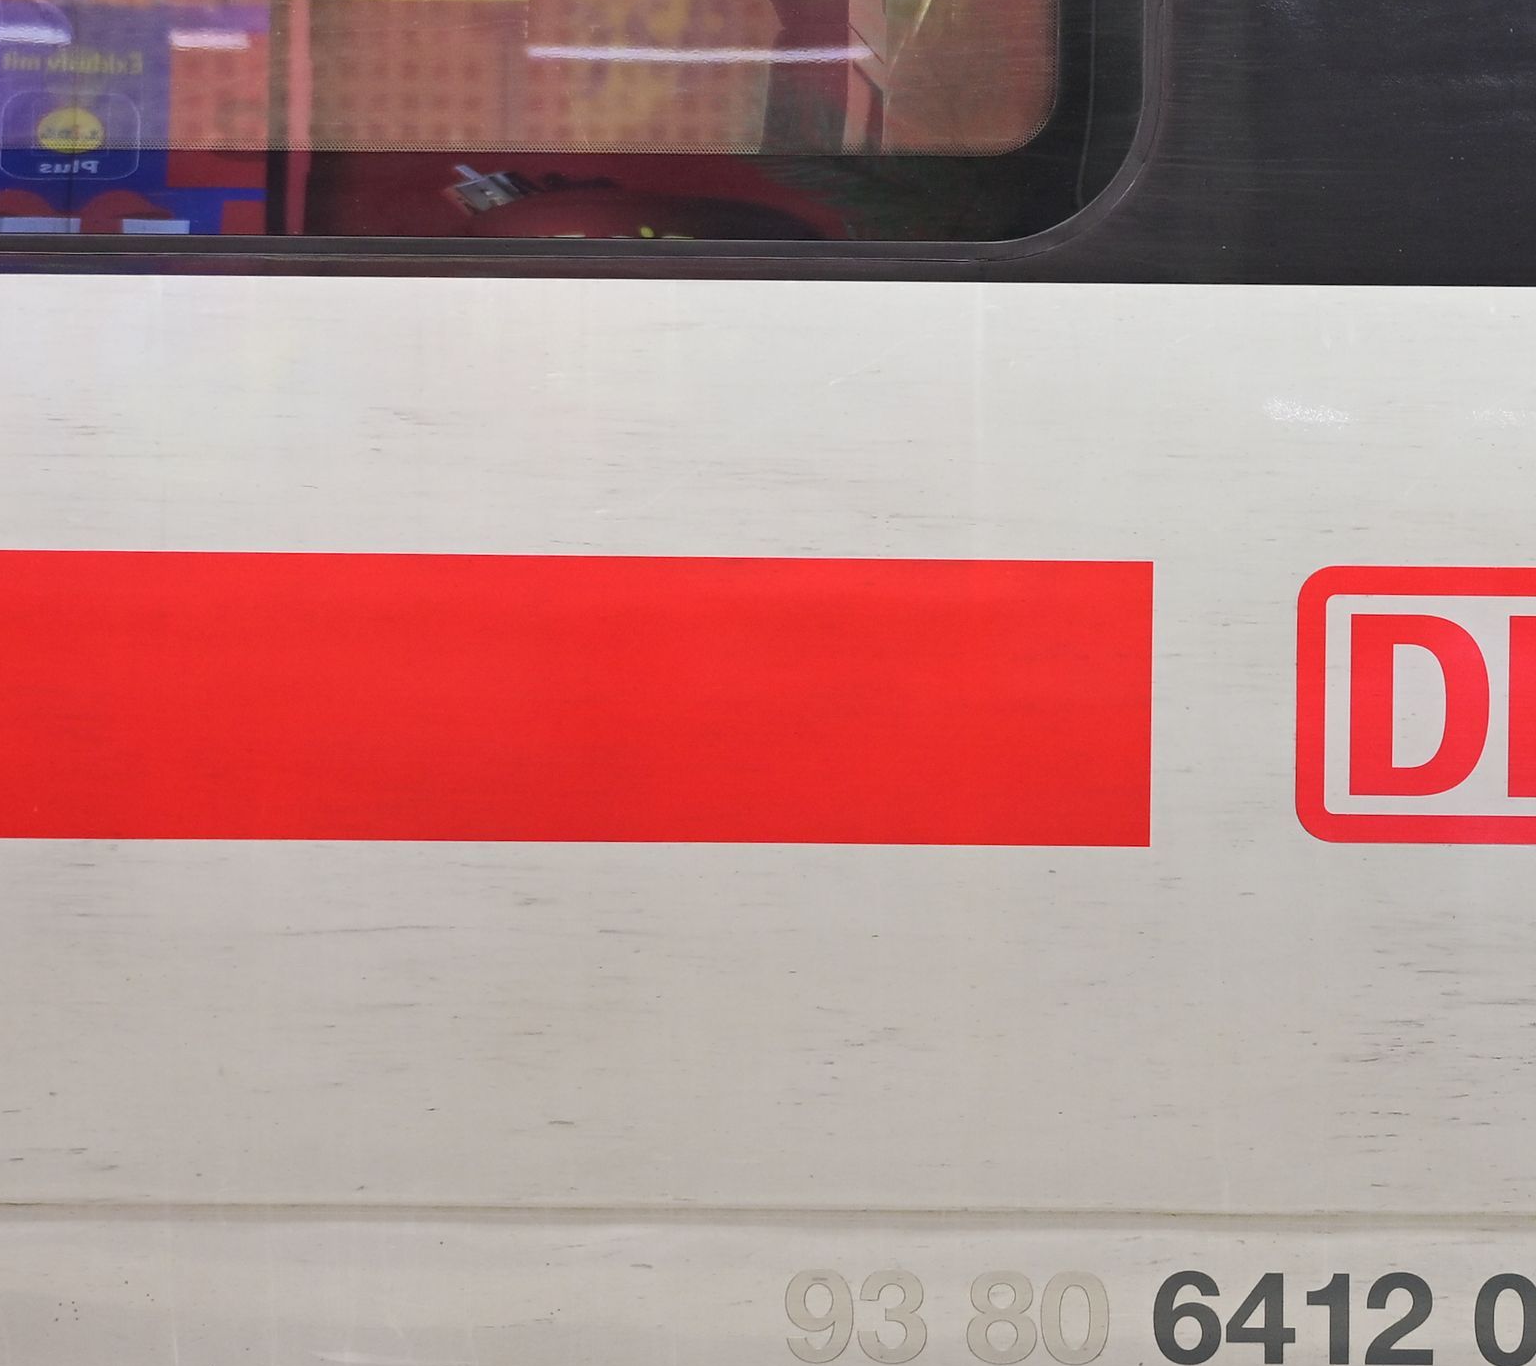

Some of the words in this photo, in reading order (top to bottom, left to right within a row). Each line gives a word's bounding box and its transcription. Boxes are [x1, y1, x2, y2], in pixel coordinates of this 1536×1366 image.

[785, 1268, 928, 1365] 93
[965, 1268, 1110, 1365] 80
[1152, 1269, 1434, 1366] 6412
